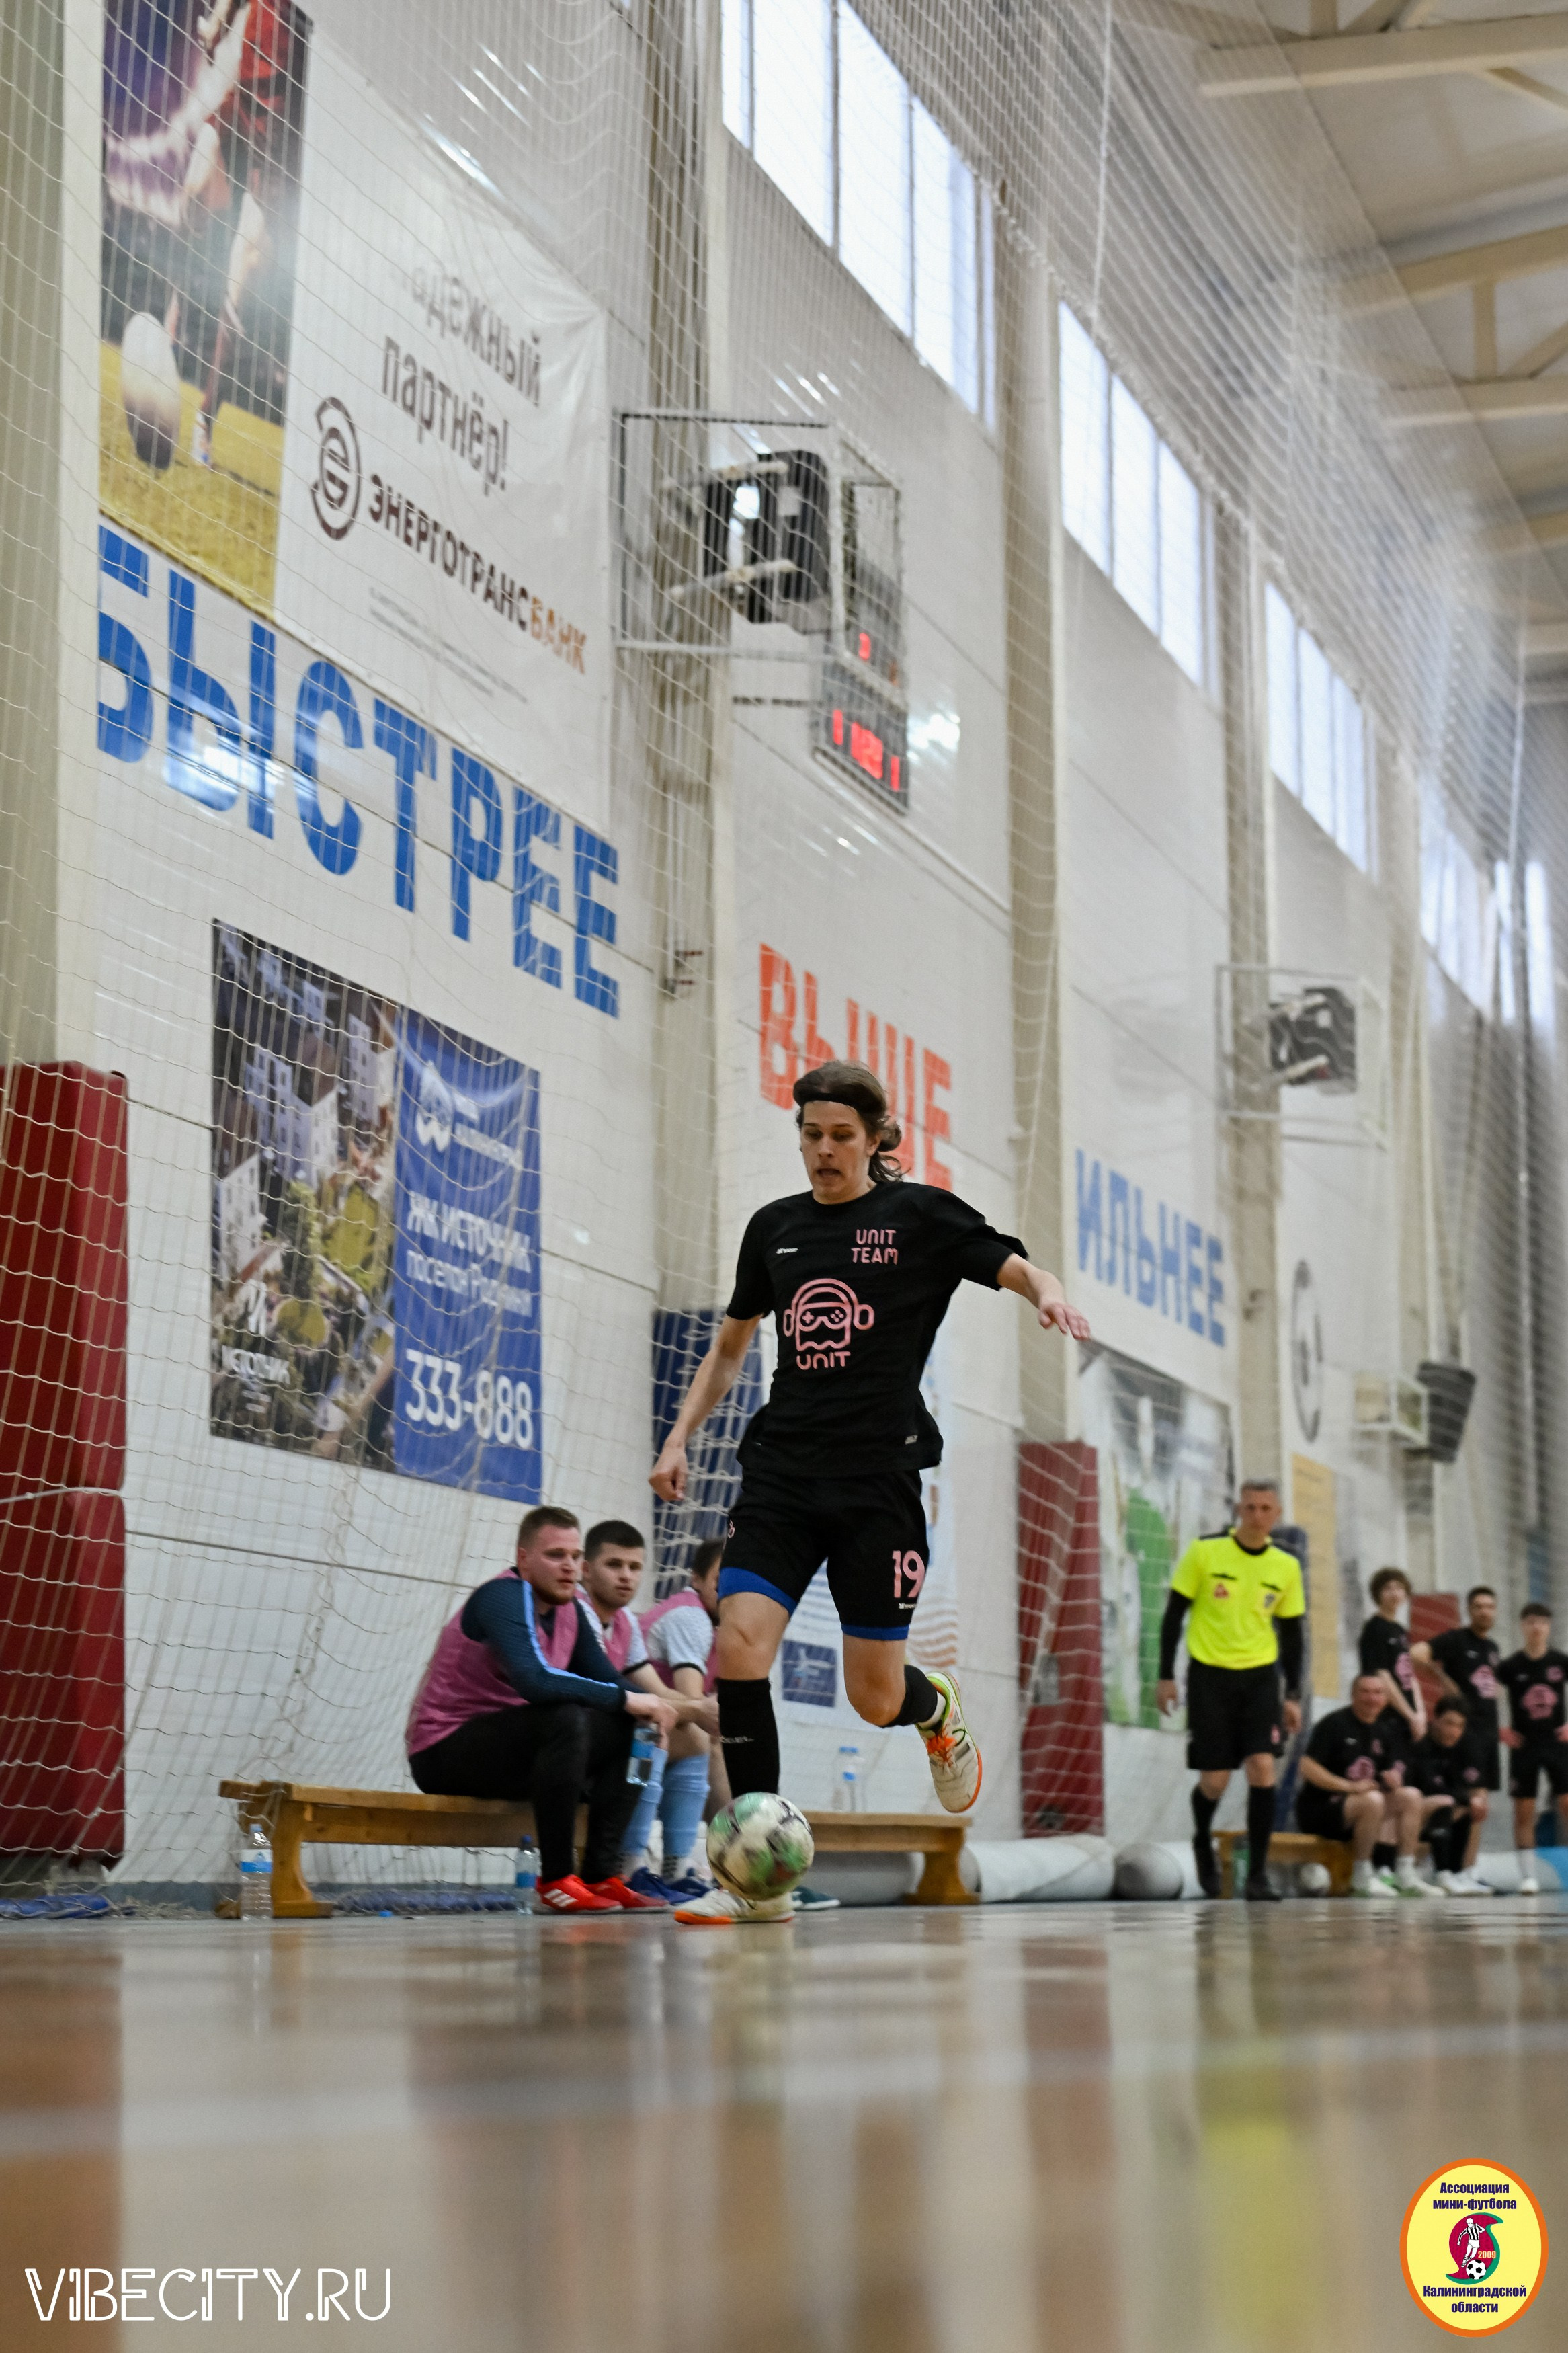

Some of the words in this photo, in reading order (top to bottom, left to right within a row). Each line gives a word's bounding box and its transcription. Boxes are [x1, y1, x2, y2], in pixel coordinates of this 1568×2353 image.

[382, 335, 508, 497] партнёр!
[368, 474, 587, 674] ЭНЕРГОТРАНСБАНК
[98, 524, 620, 1019] БЫСТРЕЕ
[851, 1247, 899, 1265] TEAM
[856, 1229, 897, 1245] UNIT
[405, 1347, 534, 1451] 333-888
[796, 1351, 852, 1371] UNIT
[892, 1550, 925, 1598] 19
